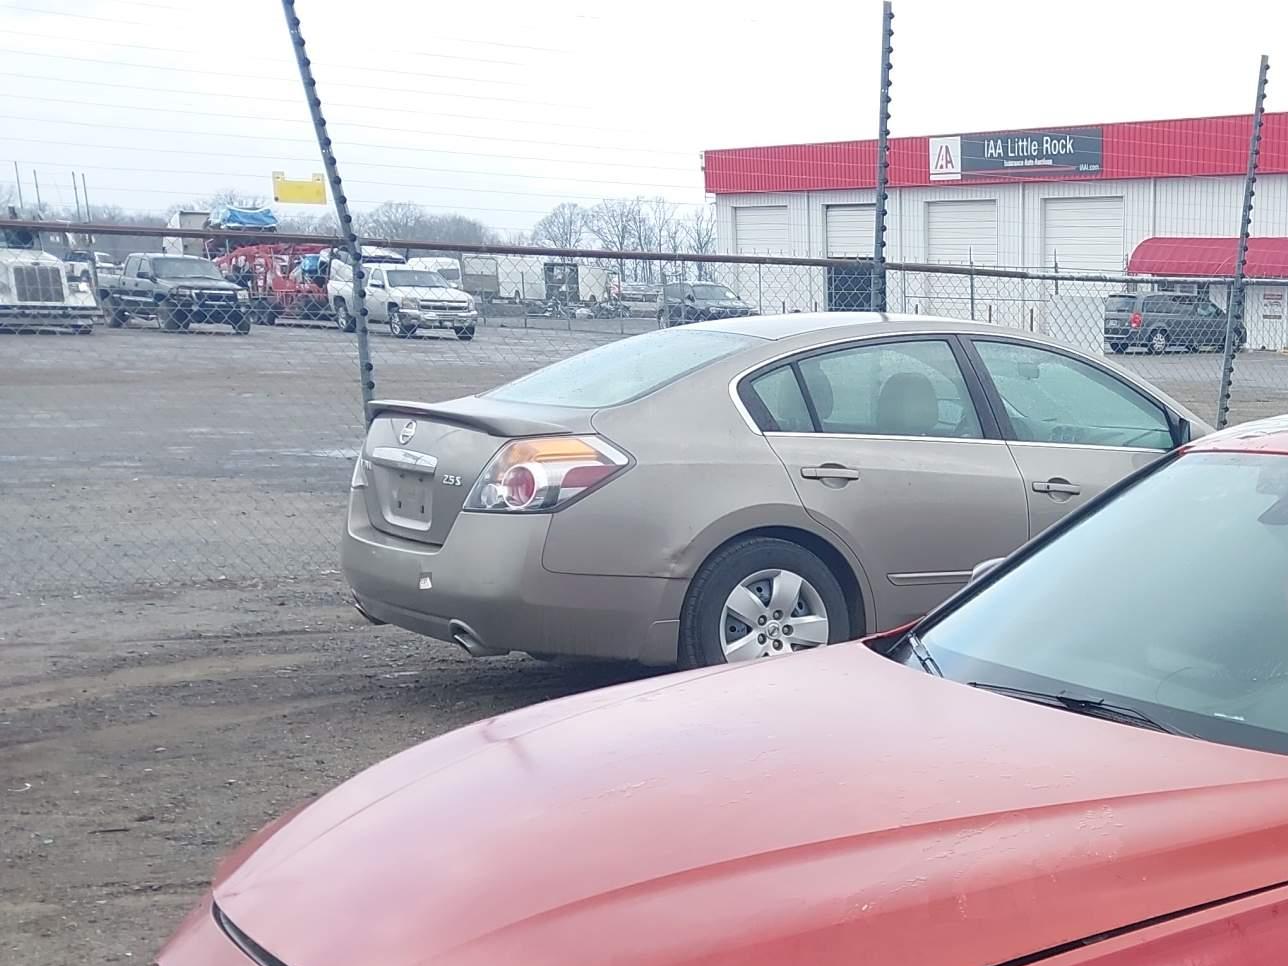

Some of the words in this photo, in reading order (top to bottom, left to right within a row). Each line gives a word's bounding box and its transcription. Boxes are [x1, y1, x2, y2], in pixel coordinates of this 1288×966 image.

[984, 138, 1004, 158] IAA
[1007, 136, 1039, 157] Little
[1043, 135, 1074, 155] Rock
